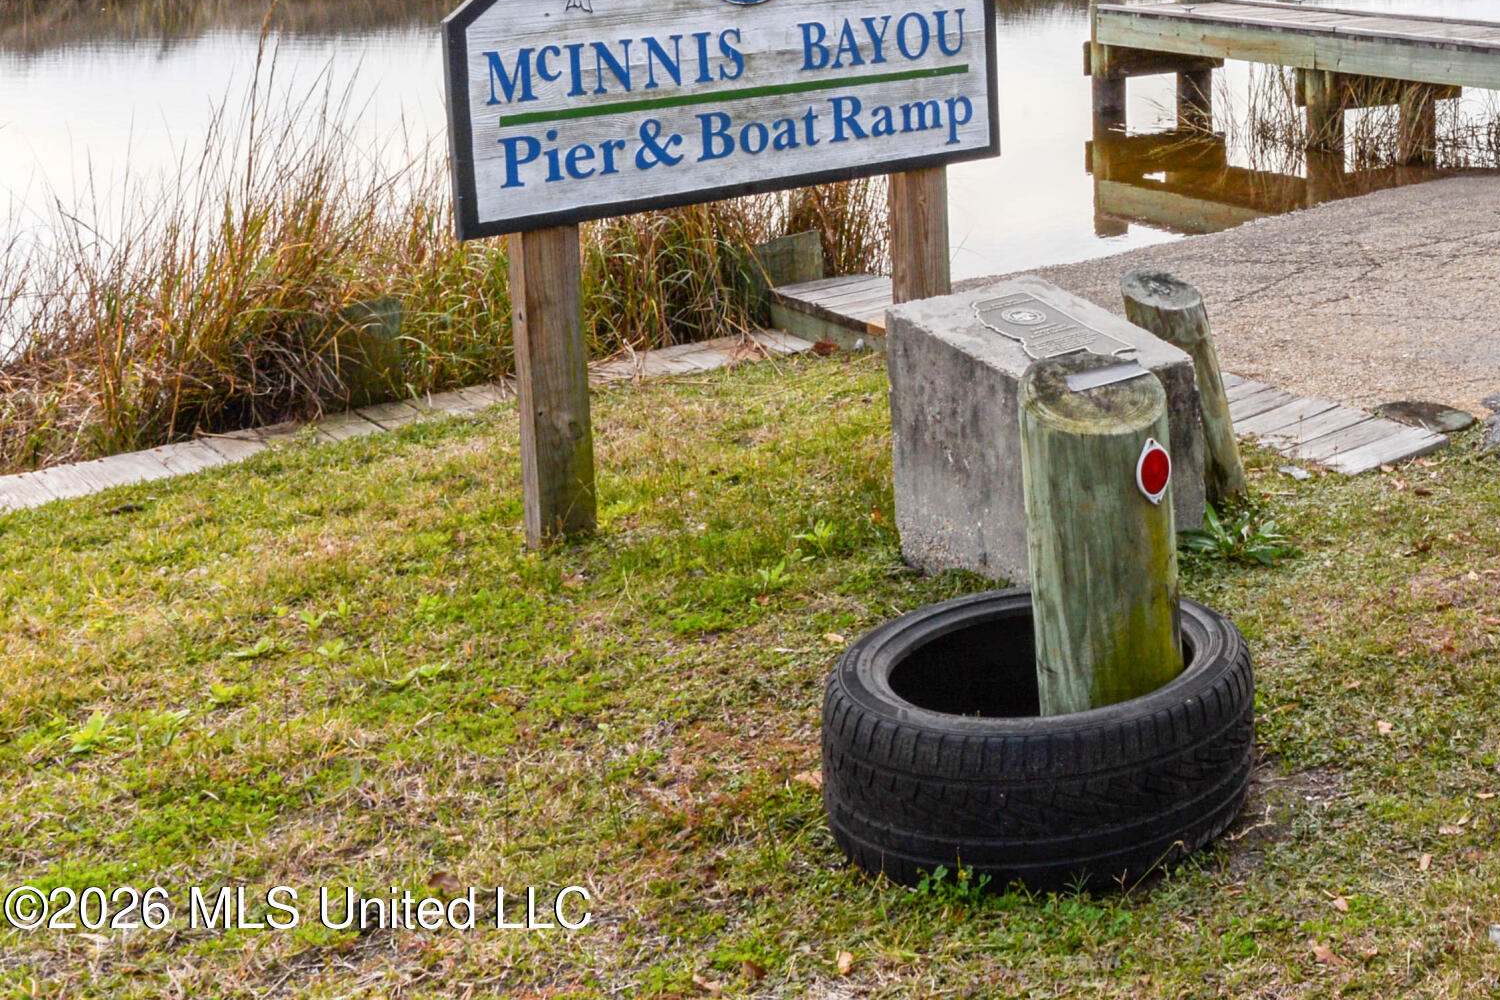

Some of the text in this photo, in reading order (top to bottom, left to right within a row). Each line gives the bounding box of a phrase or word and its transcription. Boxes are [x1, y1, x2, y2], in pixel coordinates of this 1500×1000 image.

[797, 8, 966, 71] BAYOU
[497, 95, 973, 189] Pier & Boat Ramp
